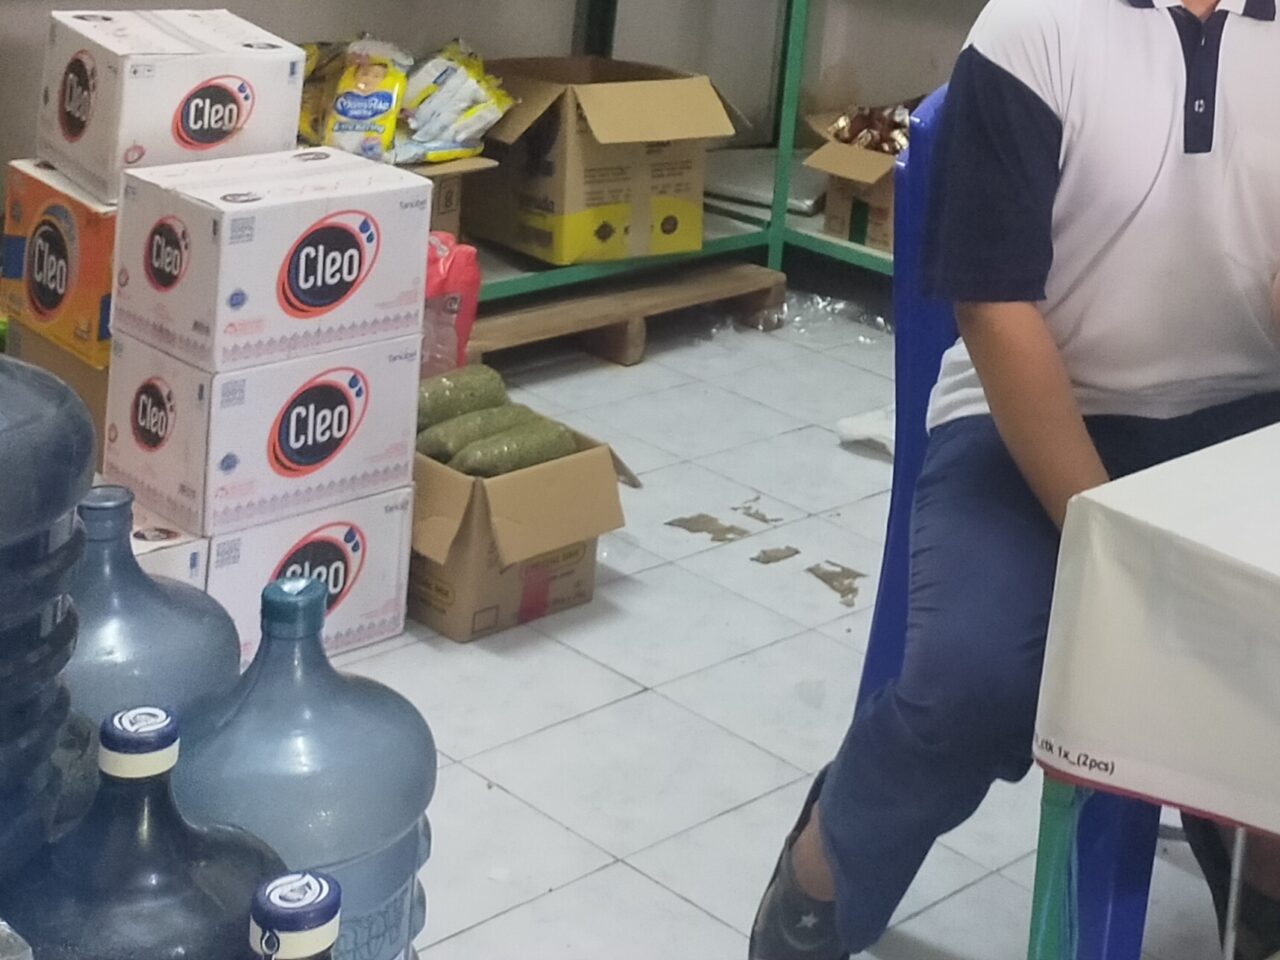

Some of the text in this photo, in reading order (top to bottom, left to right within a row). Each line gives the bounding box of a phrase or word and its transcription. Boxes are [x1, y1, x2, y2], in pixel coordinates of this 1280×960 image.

[188, 97, 239, 131] Cleo
[33, 237, 67, 296] Cleo
[152, 234, 181, 276] Cleo
[298, 243, 360, 290] Cleo
[138, 393, 167, 438] Cleo
[288, 402, 349, 450] Cleo
